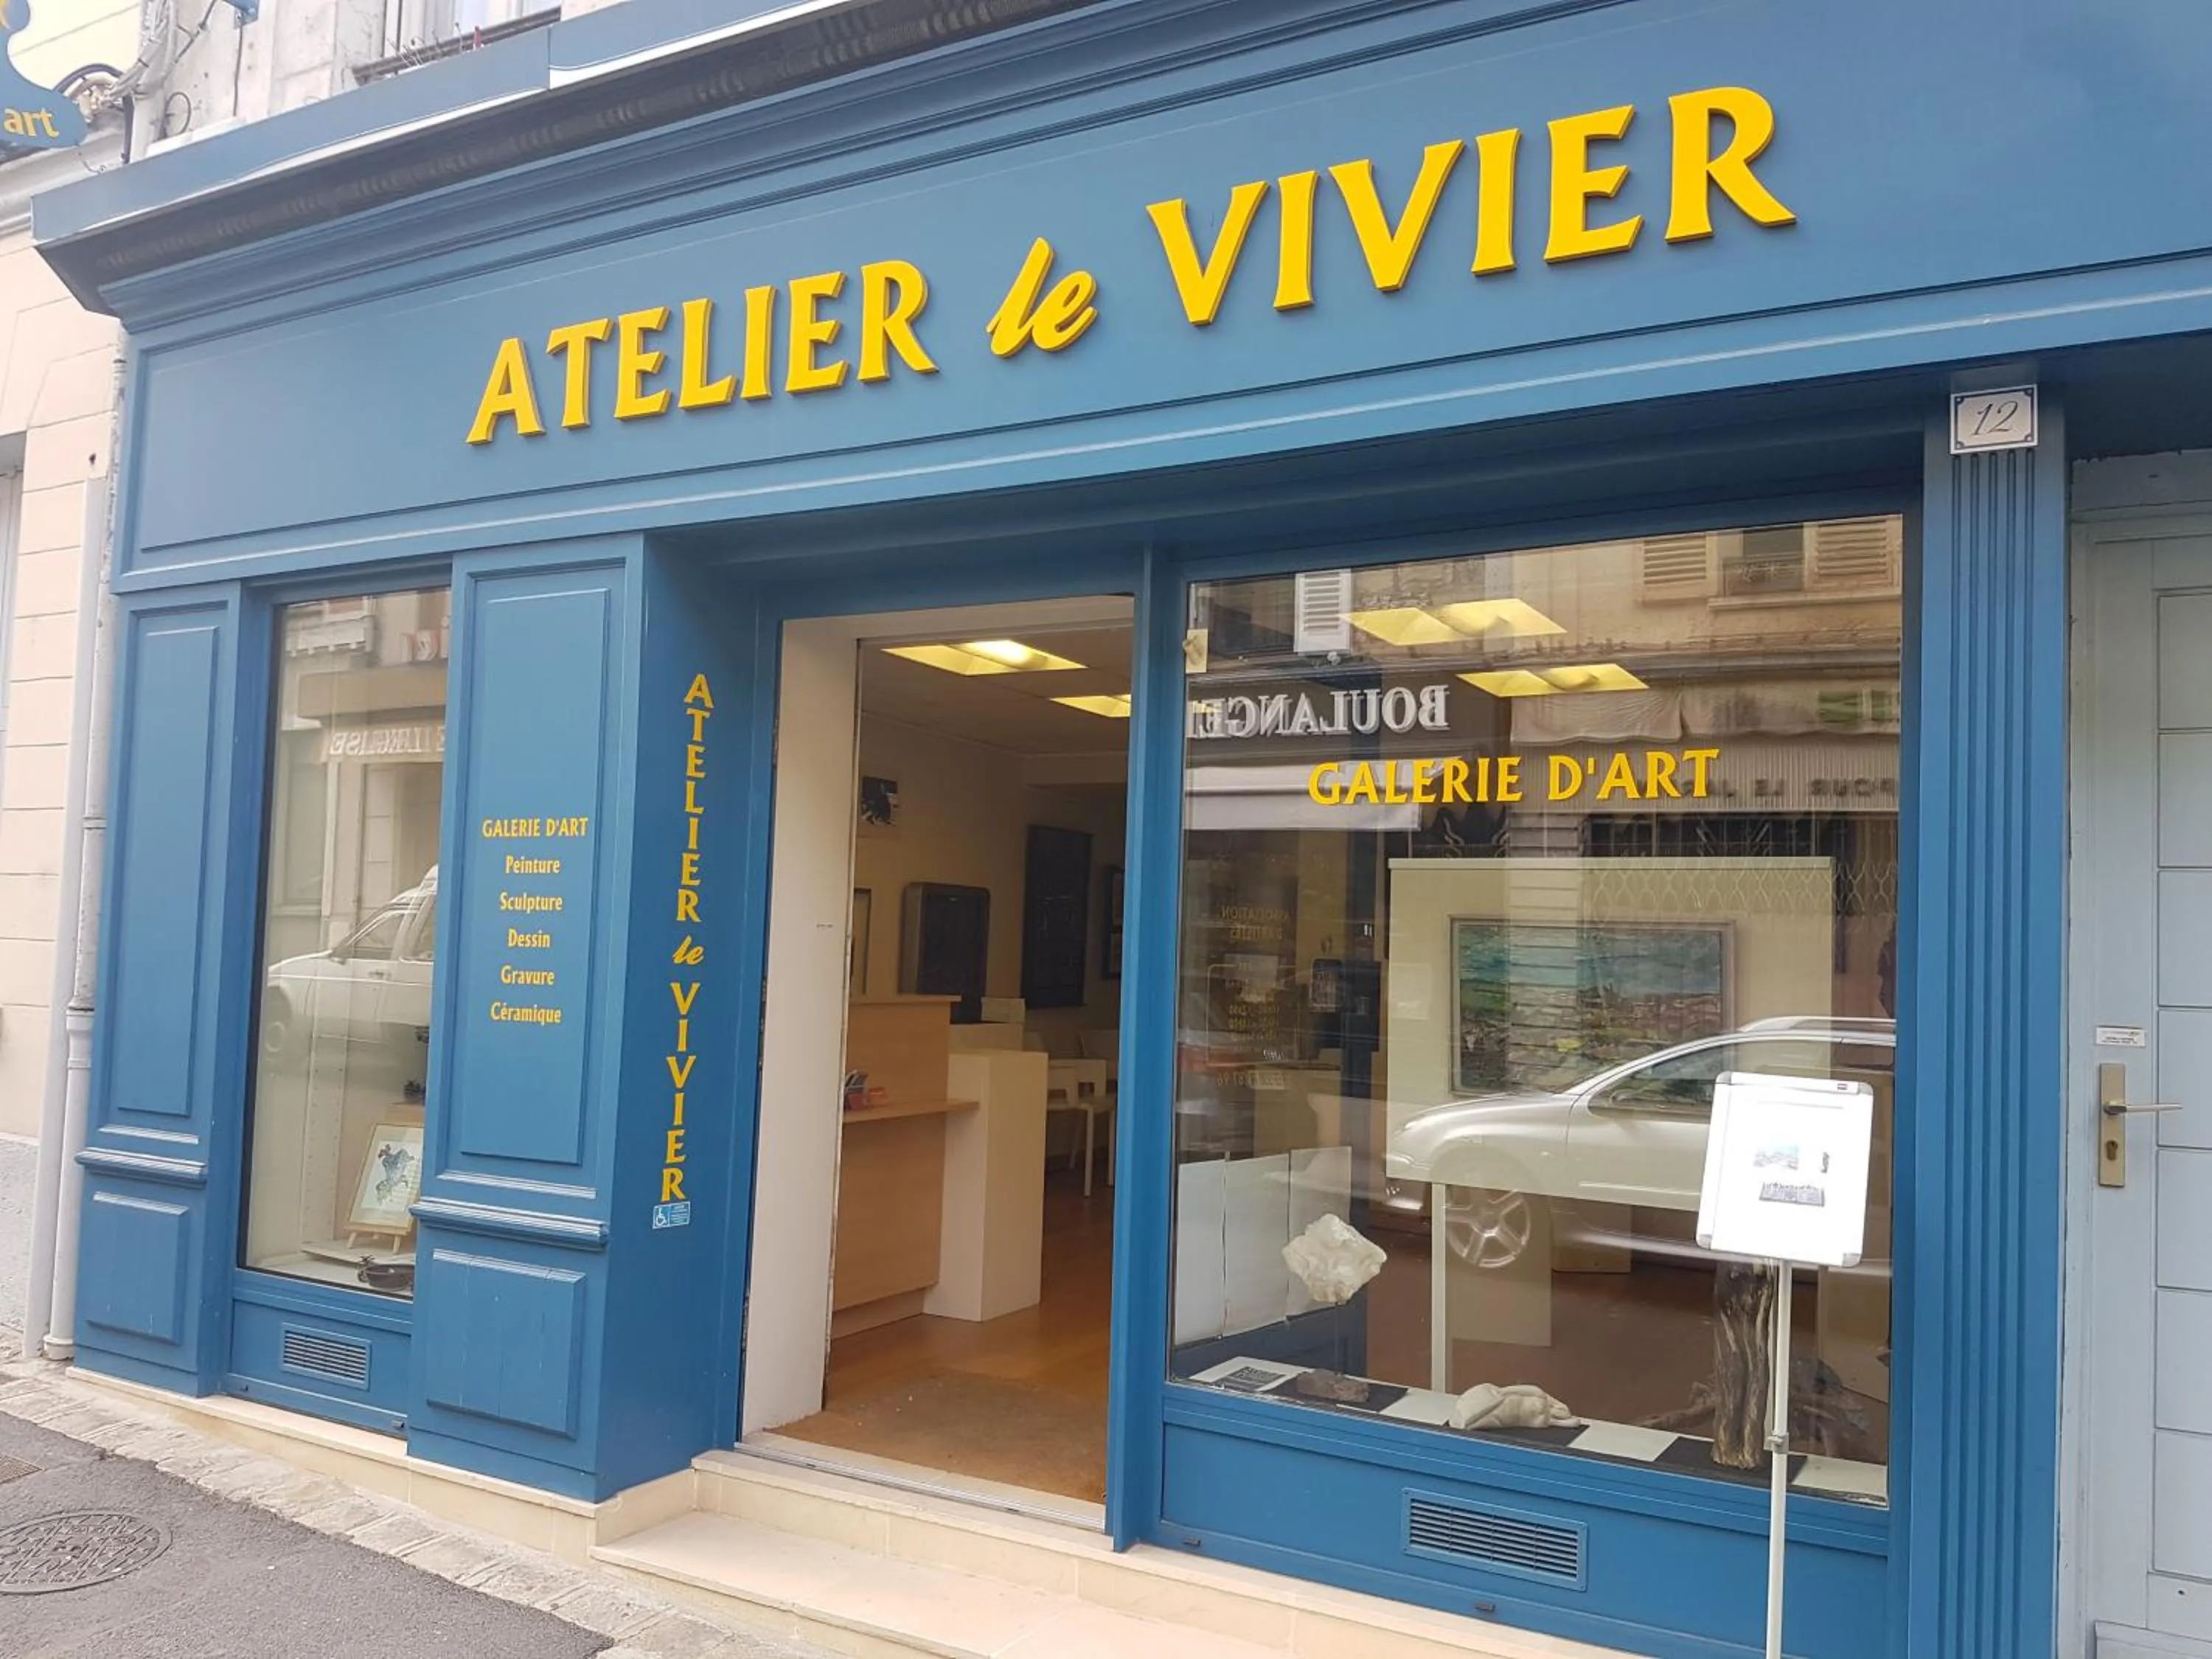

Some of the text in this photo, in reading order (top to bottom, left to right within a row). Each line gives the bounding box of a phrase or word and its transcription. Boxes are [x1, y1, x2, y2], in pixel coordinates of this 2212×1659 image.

[4, 108, 59, 138] art
[466, 86, 1796, 445] ATELIER le VIVIER
[1971, 400, 2018, 436] 12
[1307, 748, 1721, 808] GALERIE D'ART
[675, 672, 715, 923] ATELIER
[482, 816, 588, 838] GALERIE D'ART
[504, 855, 561, 874] Peinture
[499, 892, 563, 914] Sculpture
[507, 928, 552, 948] Dessin
[671, 936, 705, 967] le
[501, 966, 555, 986] Gravure
[490, 1002, 562, 1025] Céramique
[661, 981, 702, 1203] VIVIER
